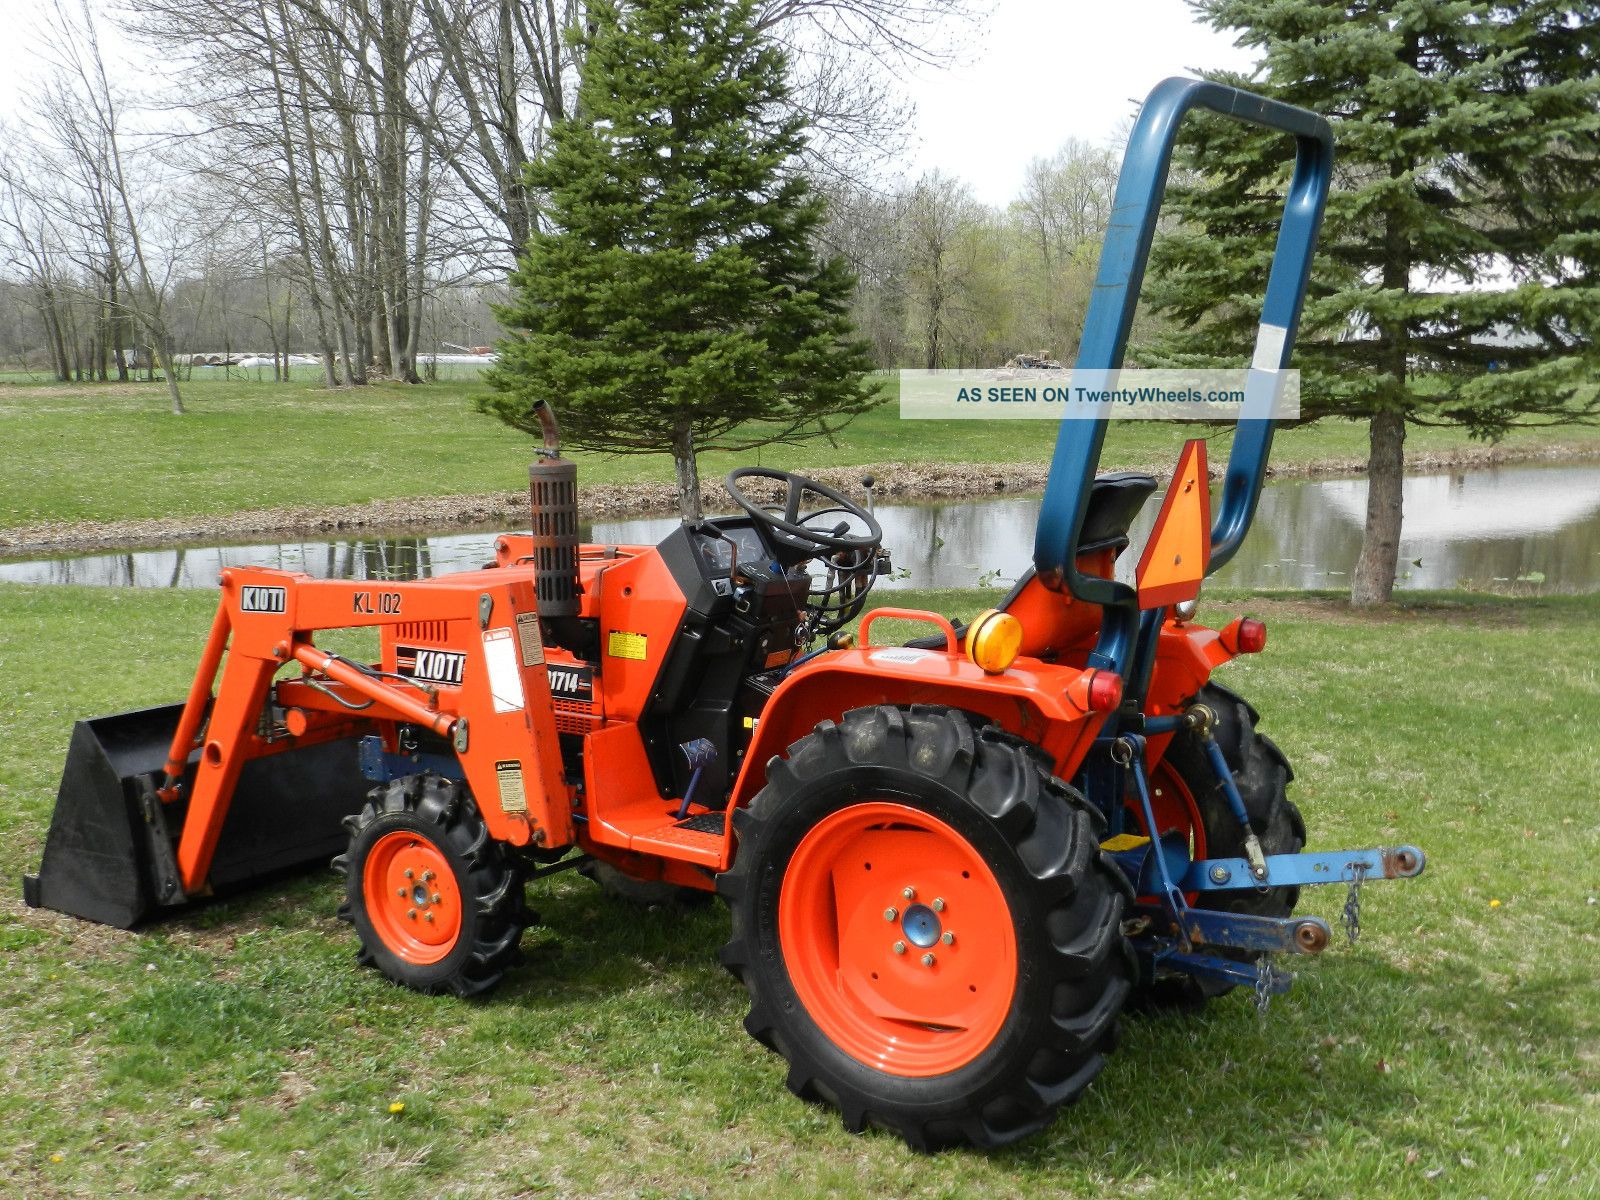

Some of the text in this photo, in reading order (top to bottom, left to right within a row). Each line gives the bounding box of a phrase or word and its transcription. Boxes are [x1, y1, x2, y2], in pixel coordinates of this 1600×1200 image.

[243, 587, 284, 611] KIOTI
[353, 592, 402, 614] KL 102
[414, 650, 465, 682] KIOTI
